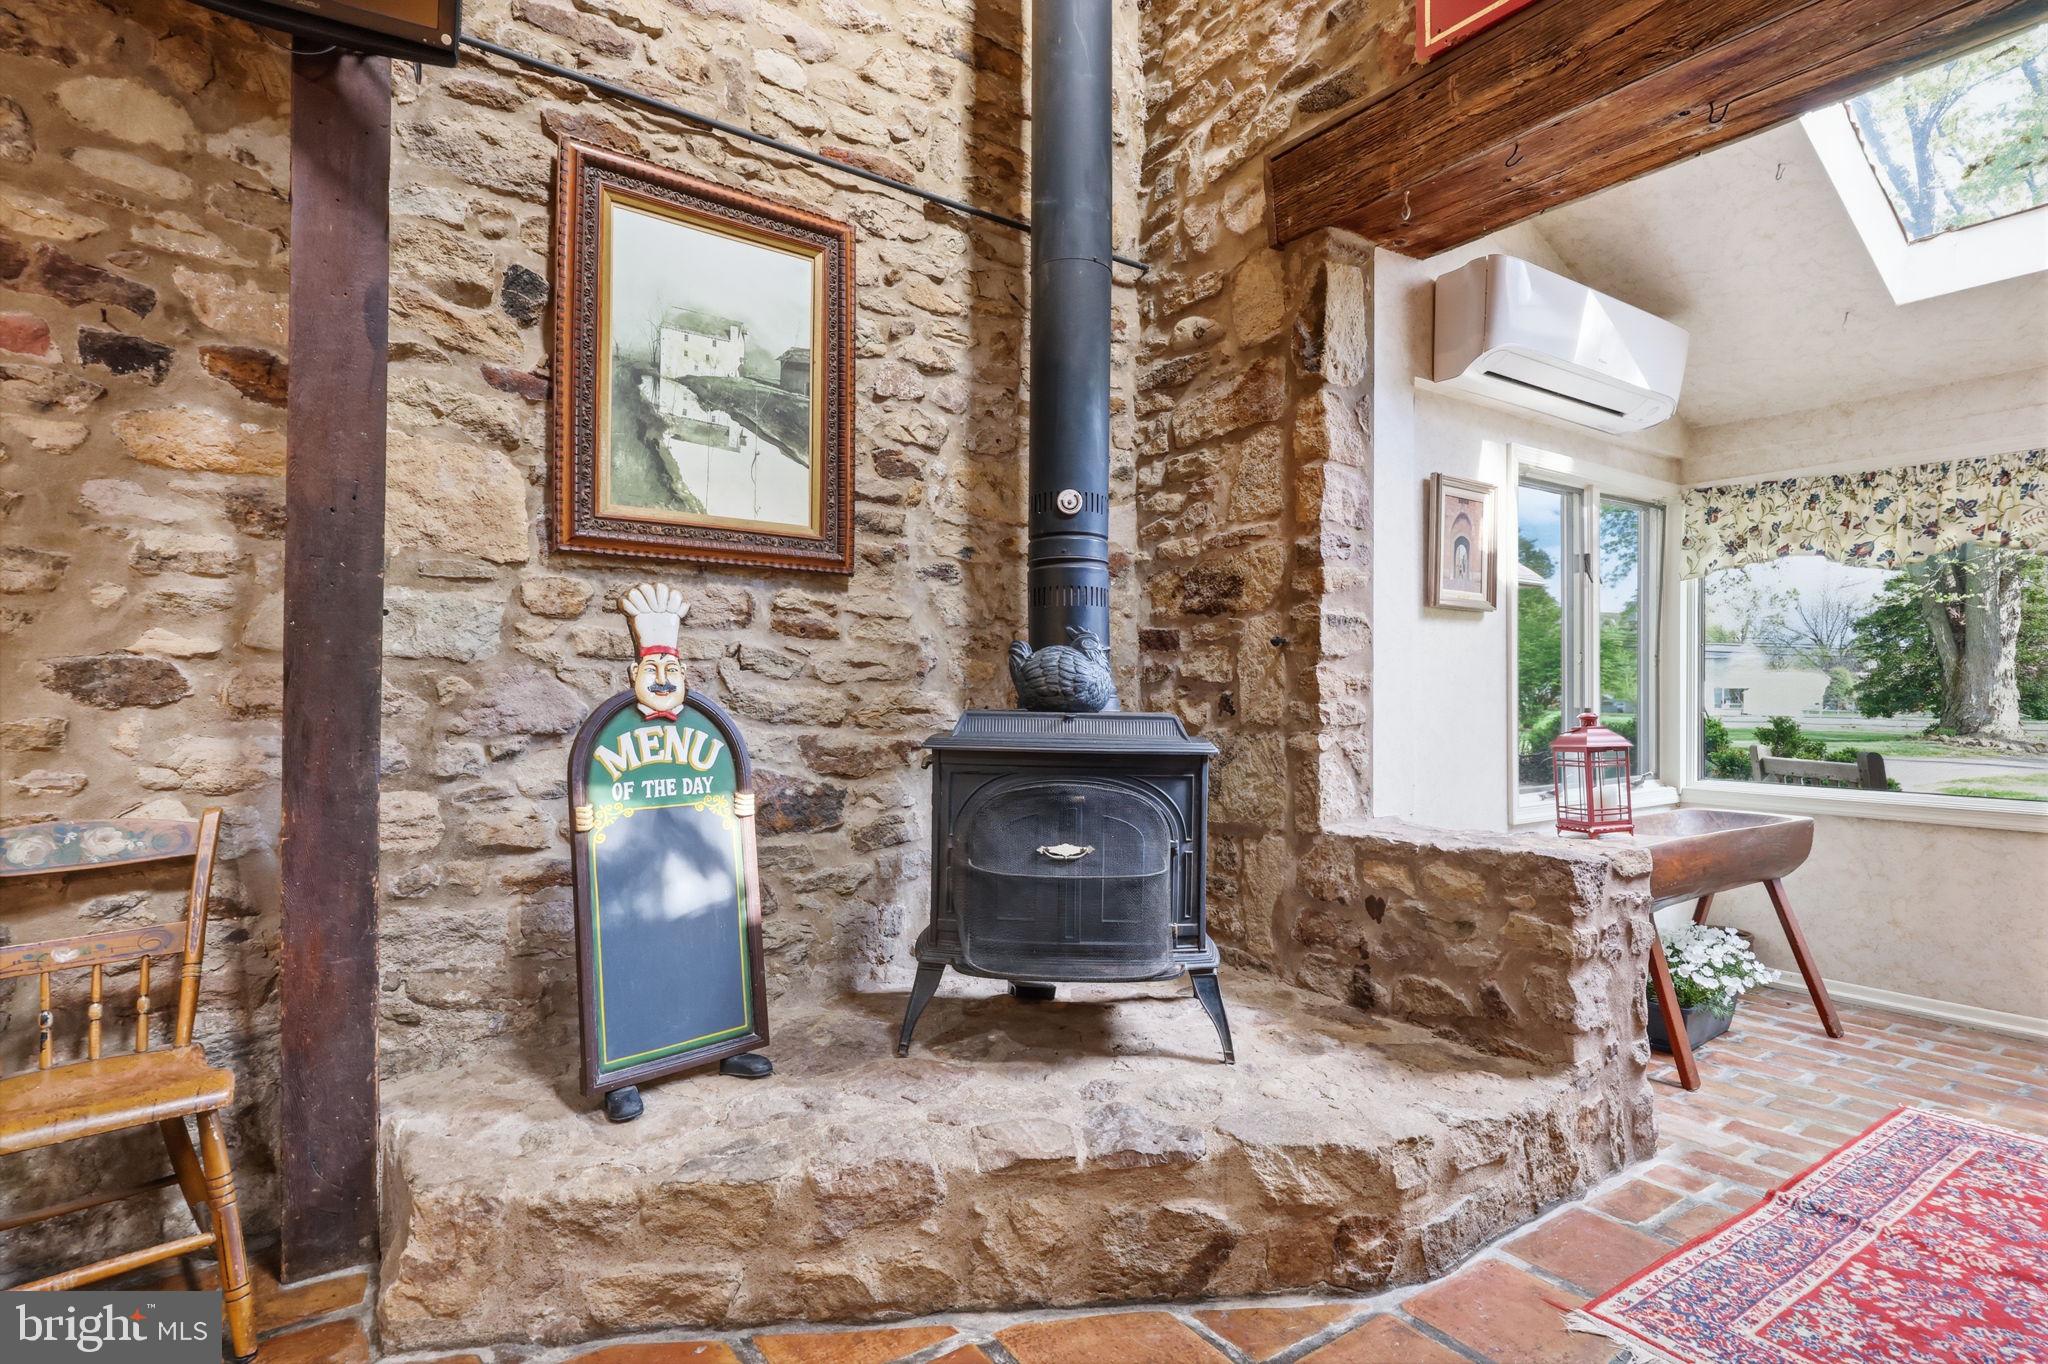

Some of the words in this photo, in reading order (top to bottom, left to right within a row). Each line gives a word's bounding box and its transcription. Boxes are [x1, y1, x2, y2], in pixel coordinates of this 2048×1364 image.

[593, 725, 725, 782] MENU
[611, 781, 635, 801] OF
[641, 778, 677, 798] THE
[682, 776, 714, 794] DAY
